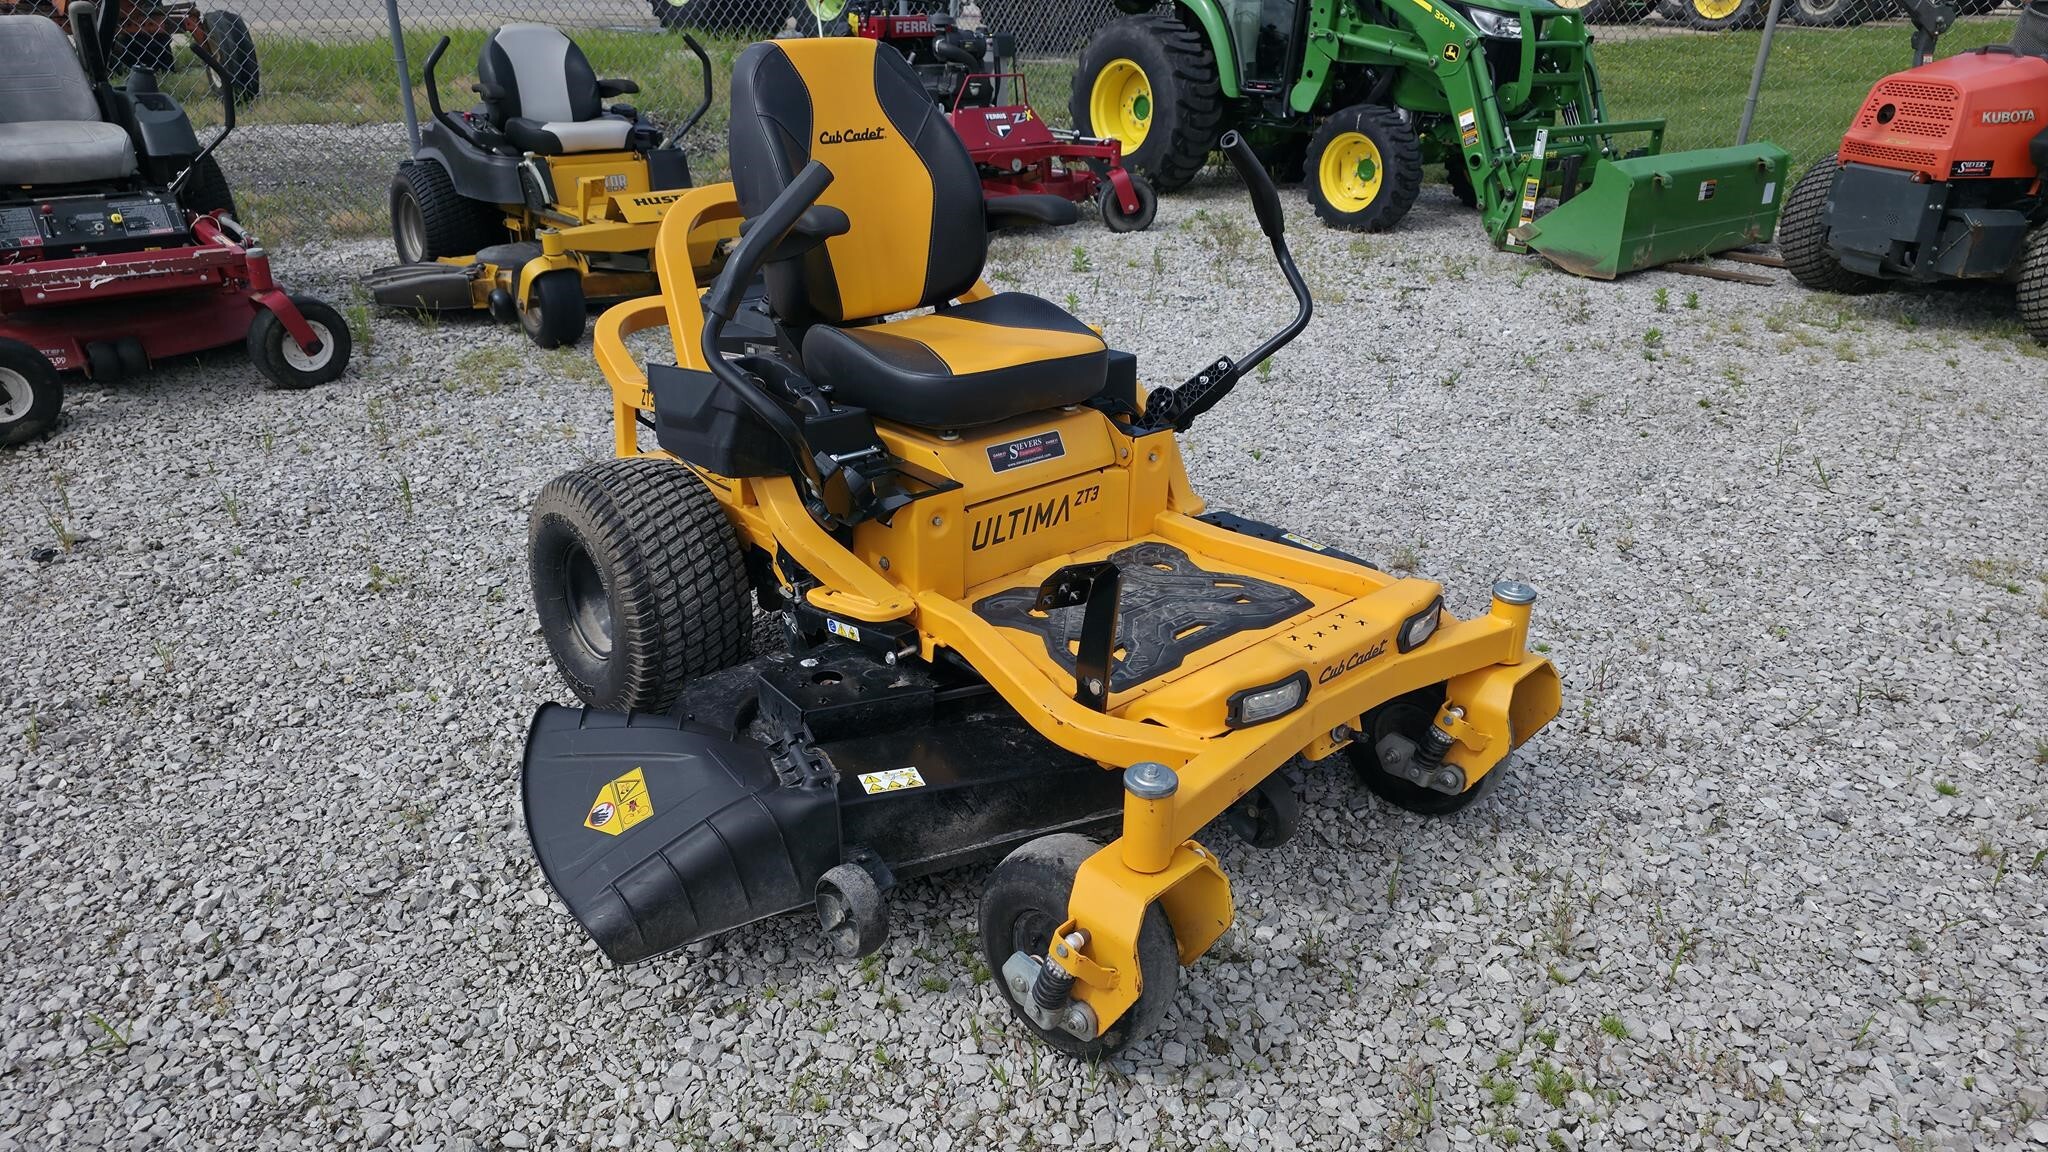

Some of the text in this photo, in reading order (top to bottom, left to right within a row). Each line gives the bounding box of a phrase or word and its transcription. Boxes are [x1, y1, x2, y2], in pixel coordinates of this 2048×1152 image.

[1434, 9, 1456, 31] 320 R
[1981, 109, 2036, 124] KUBOTA
[819, 127, 885, 145] Cub Cadet
[1957, 161, 1987, 174] SIEVERS
[633, 193, 684, 207] HUST
[641, 388, 656, 408] ZT3
[1009, 438, 1043, 460] SIEVERS
[971, 485, 1100, 552] ULTIMA ZT3
[1318, 639, 1389, 685] Cub Cadet
